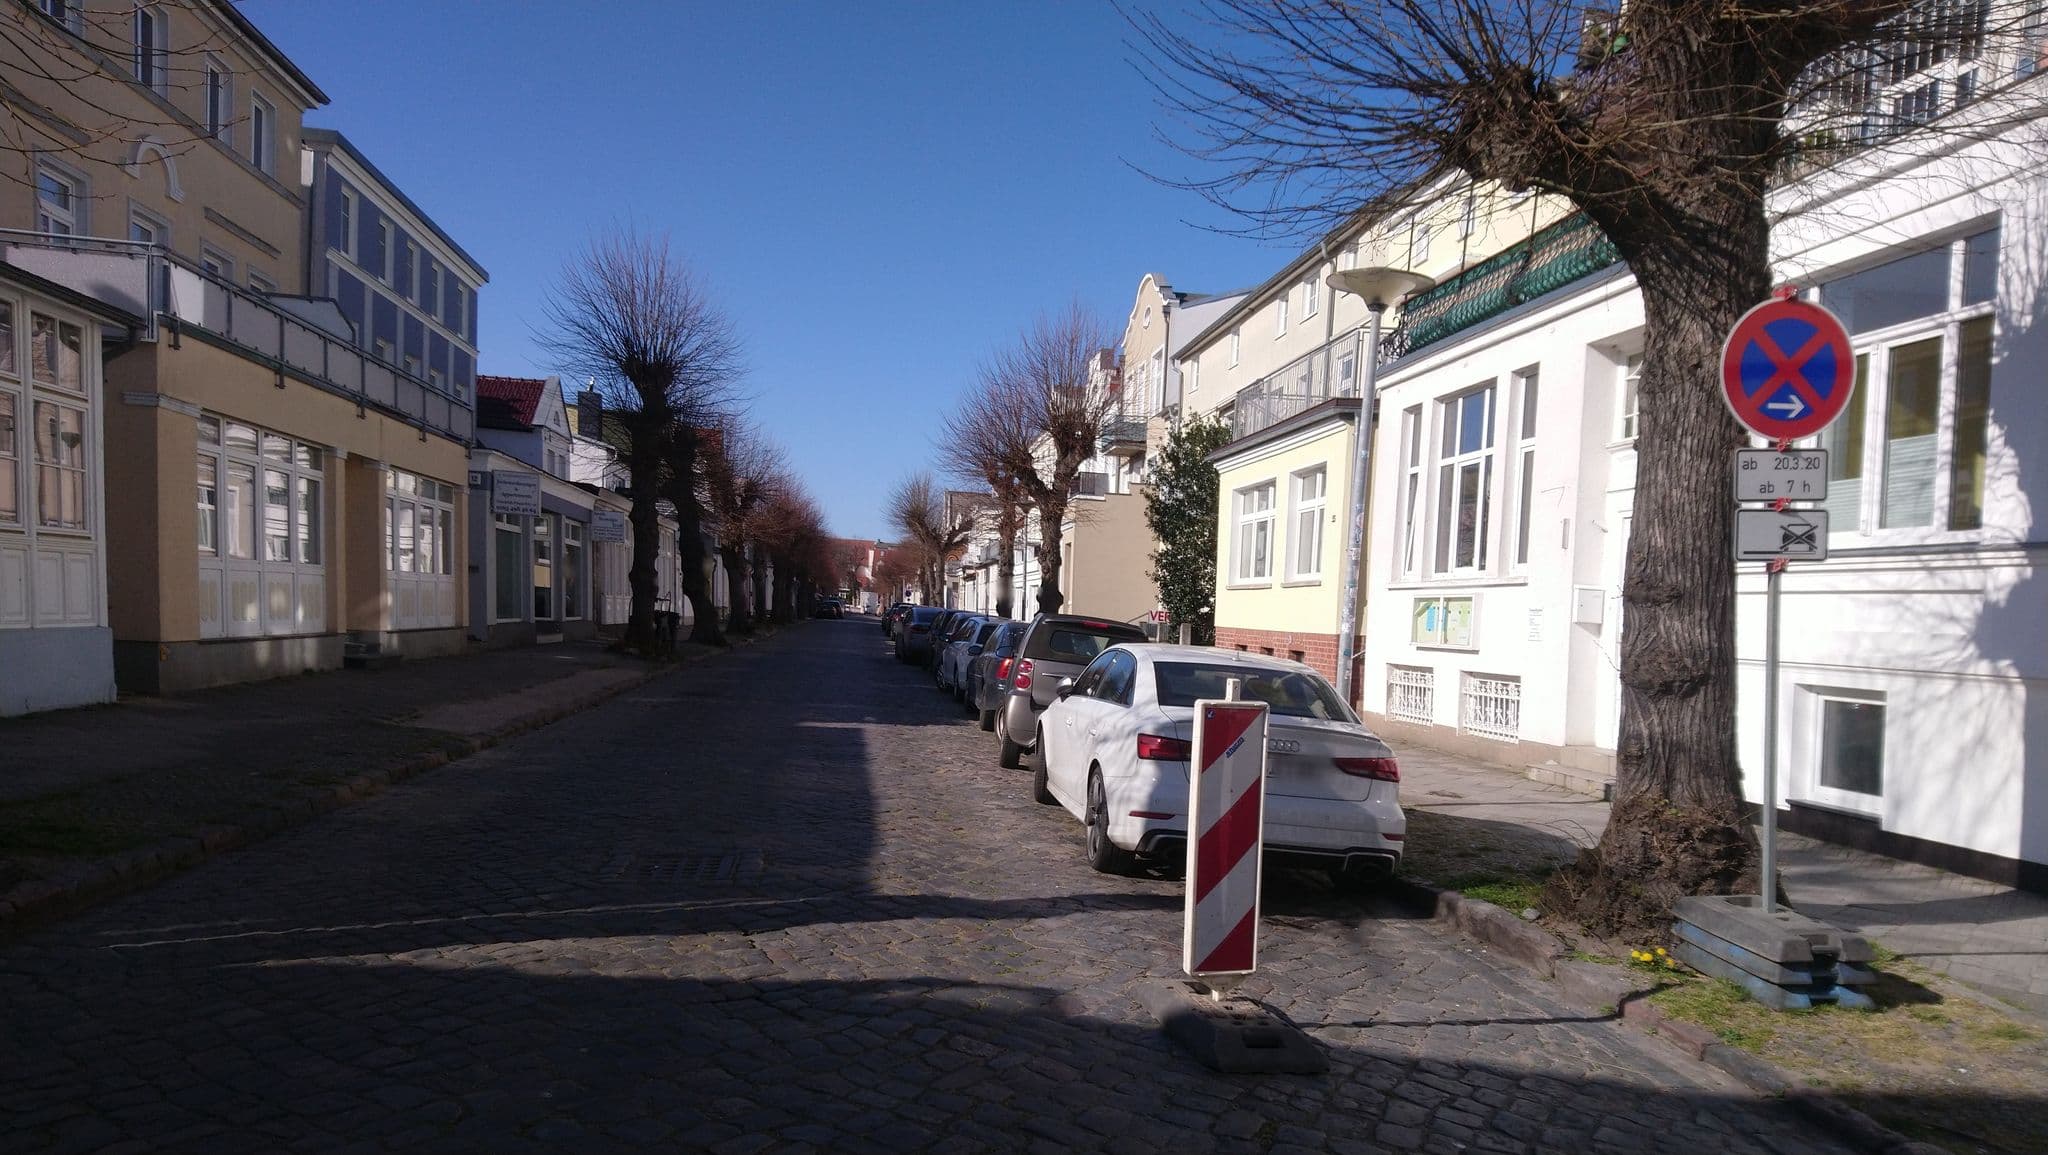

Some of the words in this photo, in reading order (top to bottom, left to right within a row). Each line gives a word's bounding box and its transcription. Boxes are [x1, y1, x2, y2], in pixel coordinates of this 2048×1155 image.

[1742, 457, 1758, 470] ab
[1774, 456, 1821, 471] 20.3.20
[1759, 480, 1775, 494] ab
[1787, 479, 1795, 493] 7
[1803, 479, 1811, 493] h
